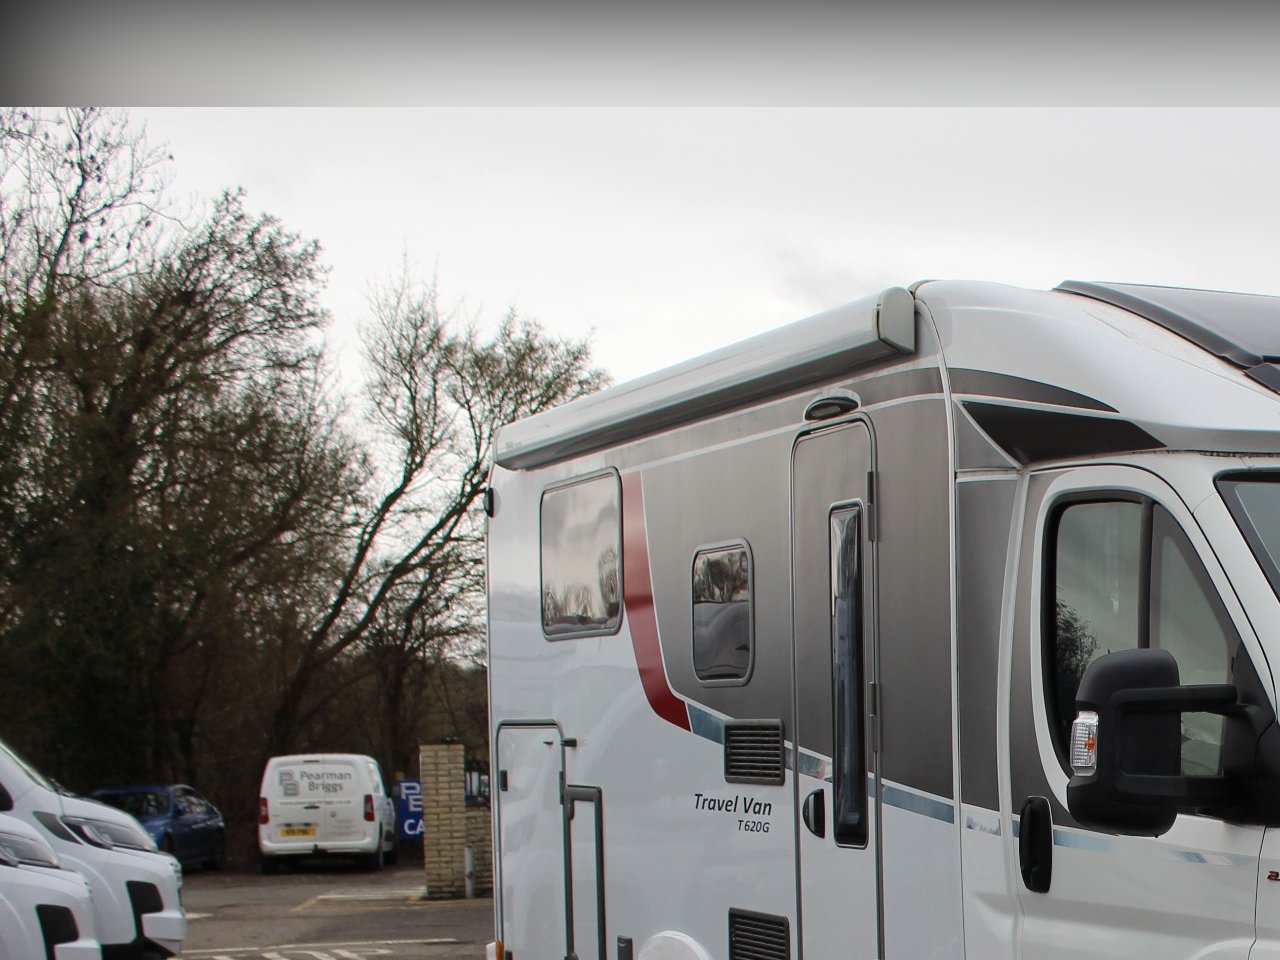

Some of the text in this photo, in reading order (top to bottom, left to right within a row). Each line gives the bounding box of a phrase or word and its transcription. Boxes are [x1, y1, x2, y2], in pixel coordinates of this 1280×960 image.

[300, 770, 352, 781] Pearman
[308, 781, 344, 793] Briggs
[694, 793, 772, 816] Travel Van
